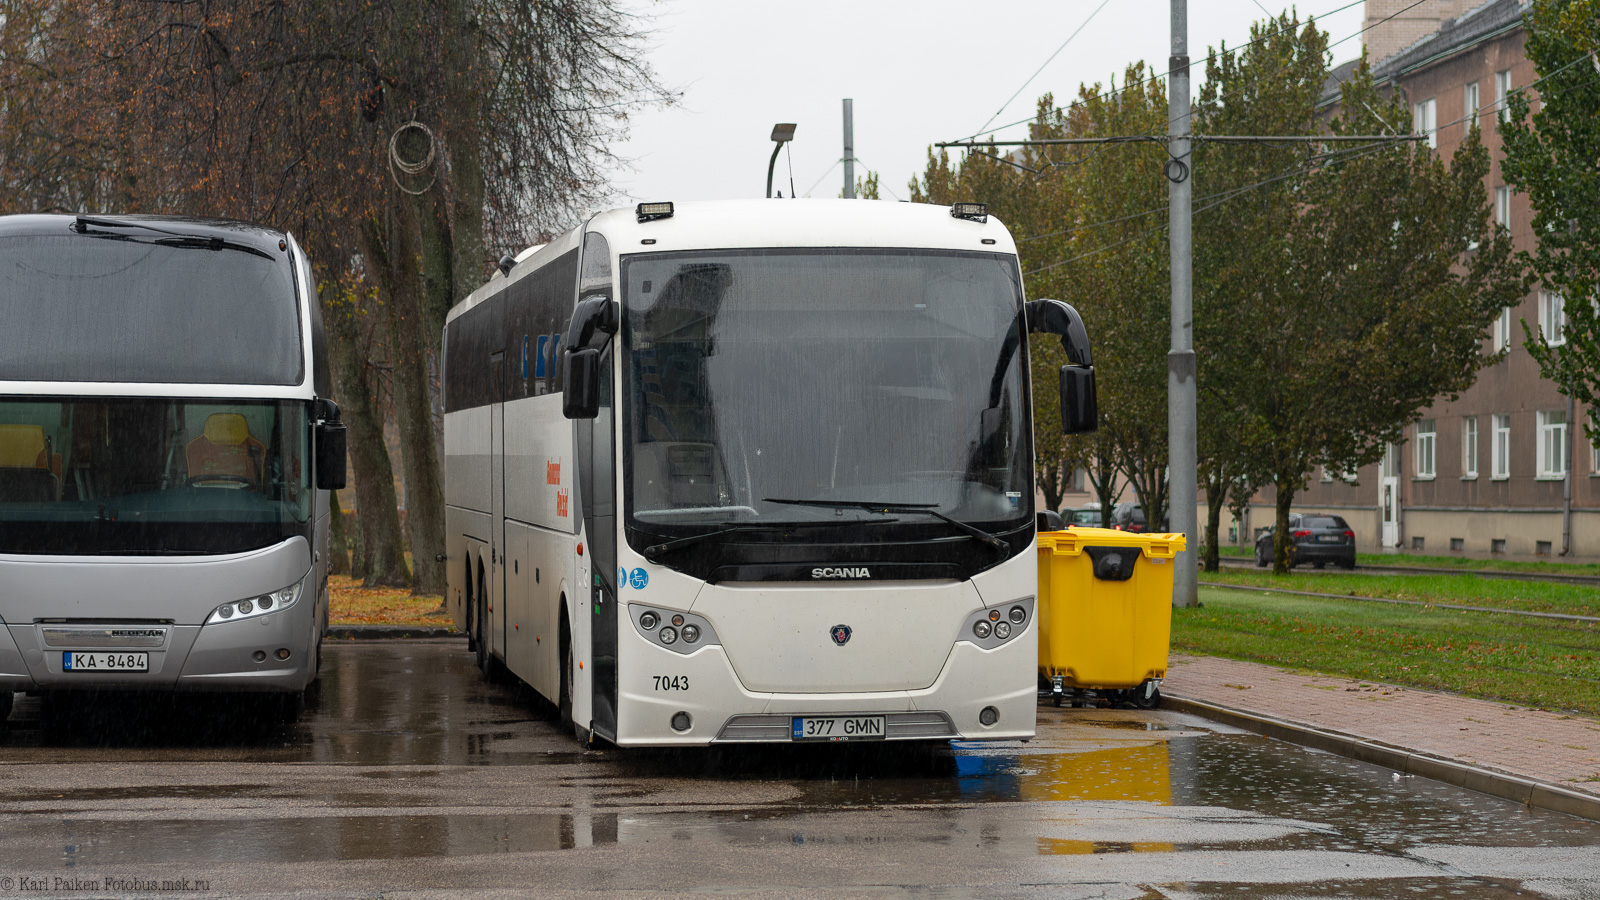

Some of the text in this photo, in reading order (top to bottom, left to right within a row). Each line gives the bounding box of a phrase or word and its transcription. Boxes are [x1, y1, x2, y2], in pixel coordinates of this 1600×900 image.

[811, 567, 871, 579] SCANIA
[111, 629, 164, 637] NEOPLAN
[75, 654, 145, 668] KA-8484
[652, 675, 689, 691] 7043
[806, 718, 880, 735] 377 GMN
